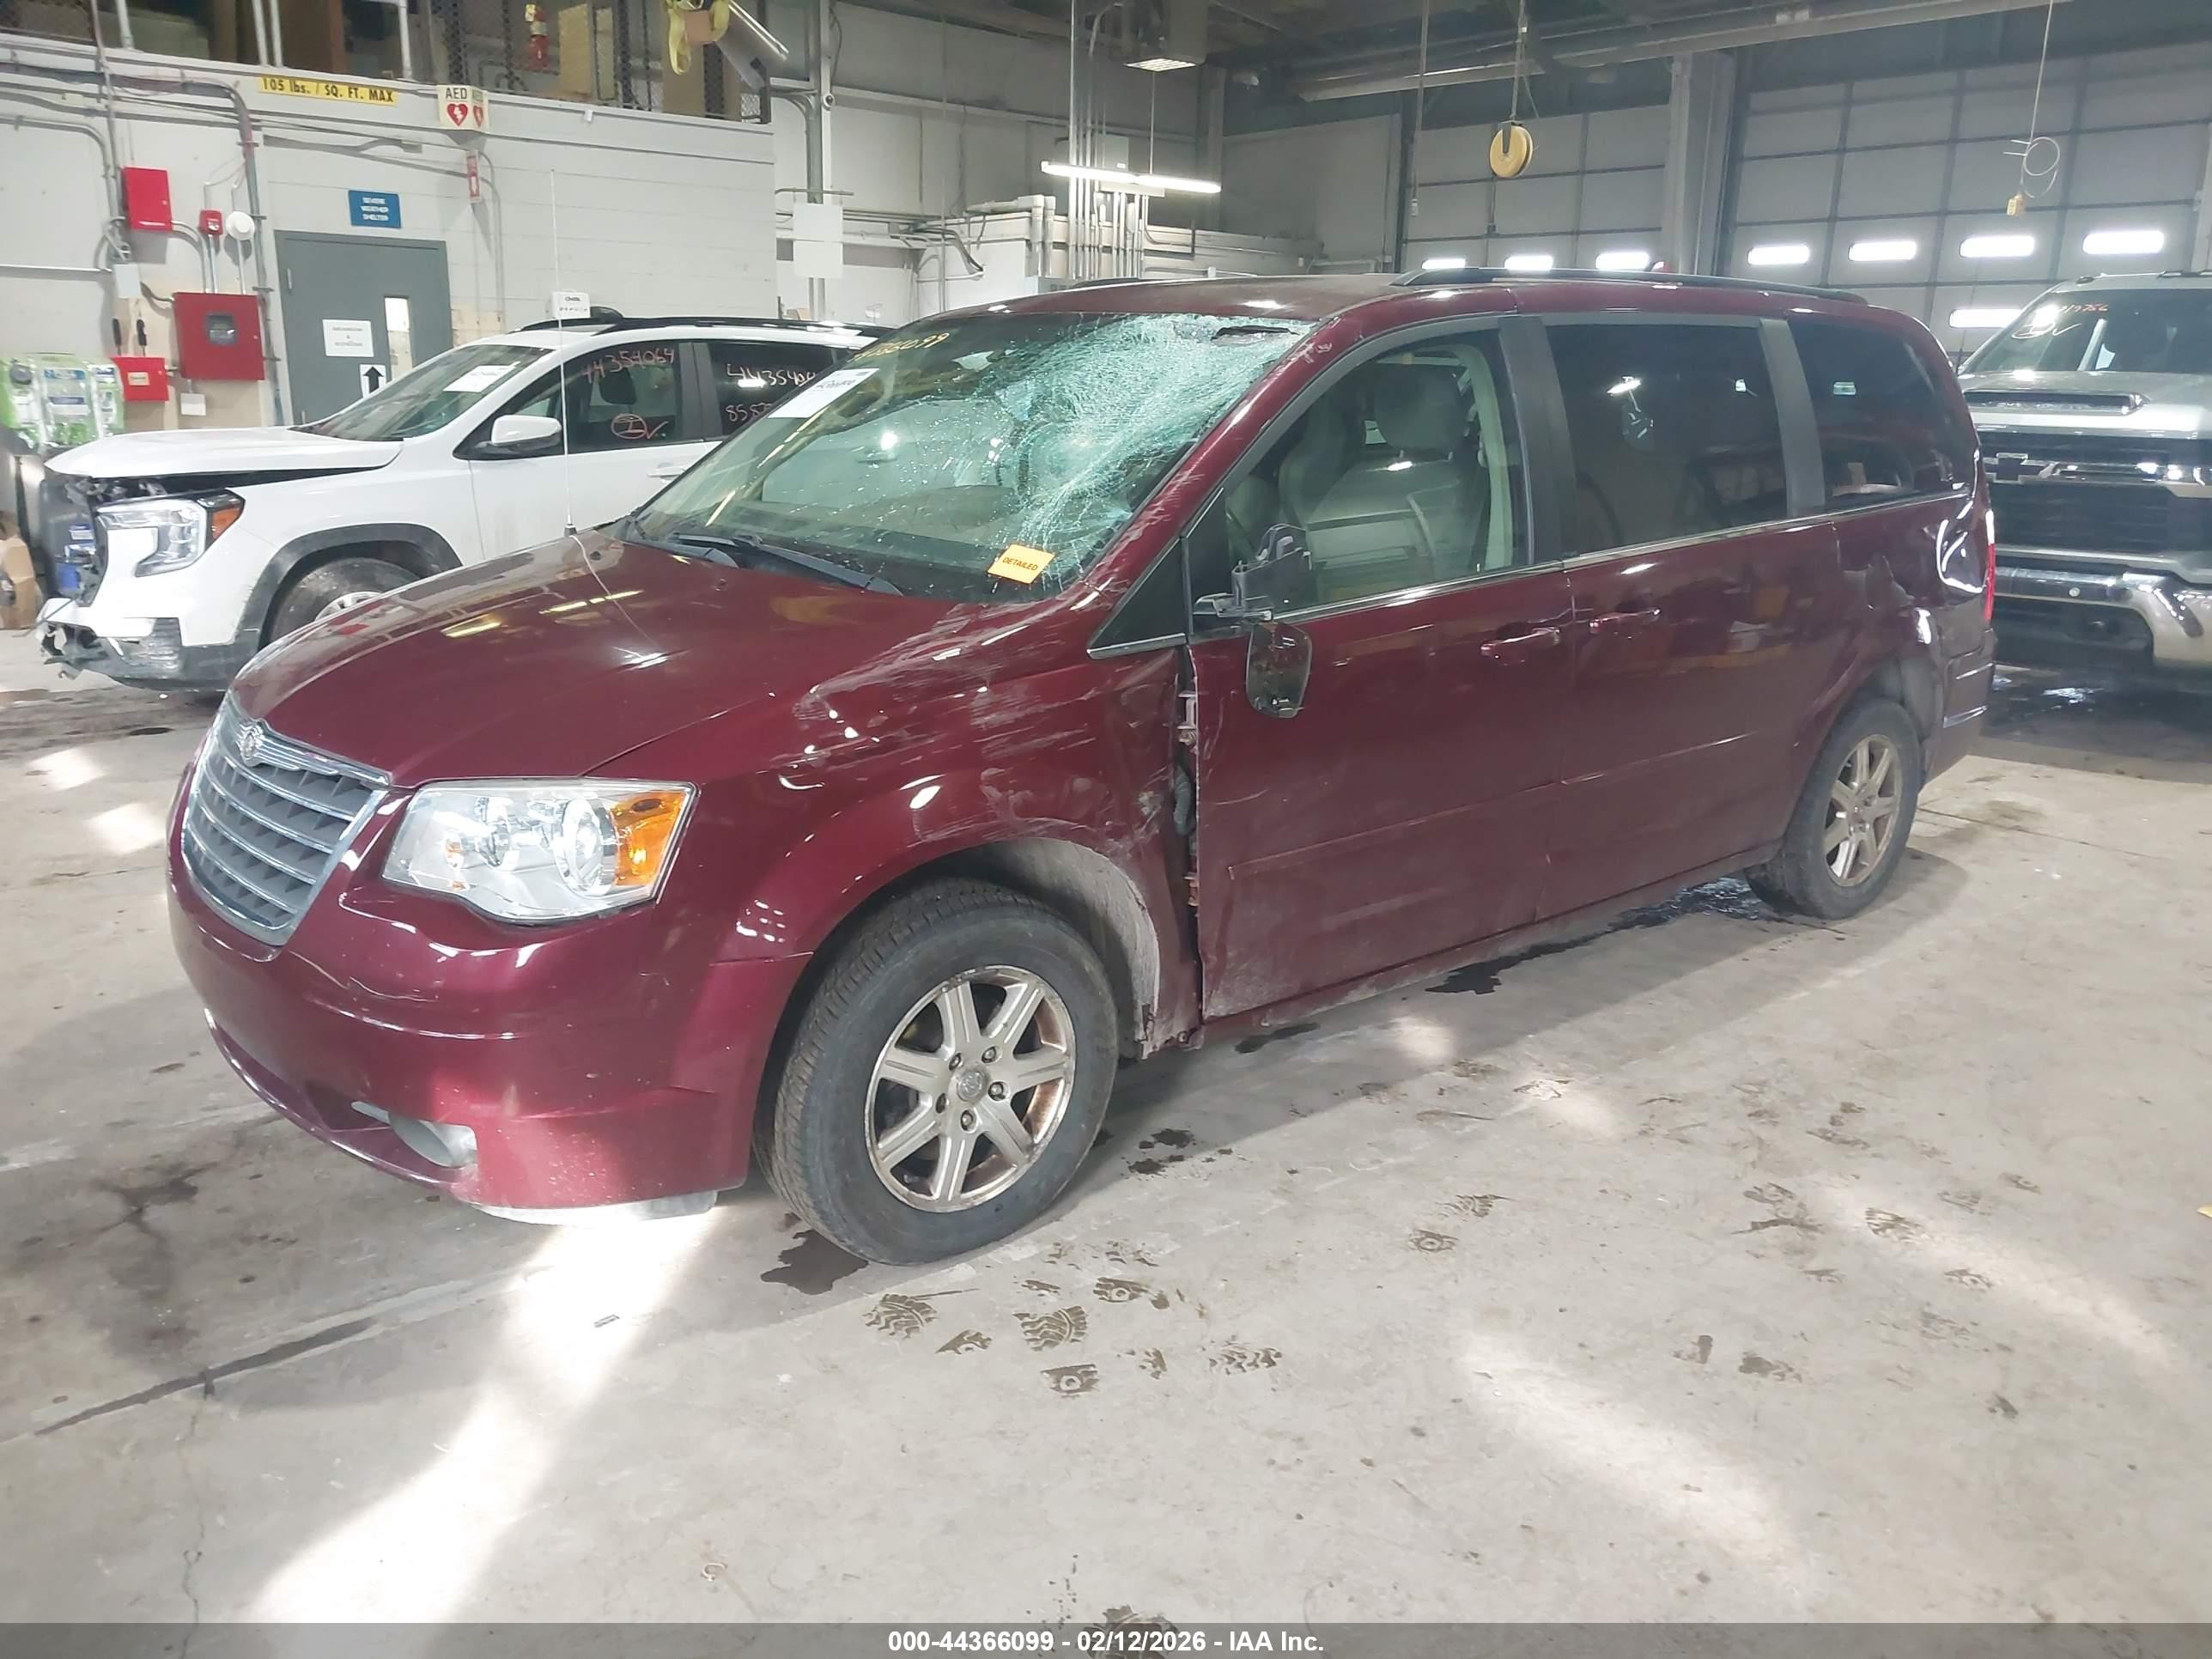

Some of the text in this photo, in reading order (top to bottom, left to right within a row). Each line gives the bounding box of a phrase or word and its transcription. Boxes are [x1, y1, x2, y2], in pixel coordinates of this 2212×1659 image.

[262, 77, 285, 91] 105
[289, 79, 311, 94] lbs.
[325, 84, 343, 98] SQ.
[348, 87, 364, 100] FT.
[368, 88, 394, 103] MAX
[446, 87, 467, 100] AED
[1002, 556, 1038, 571] DETAILED
